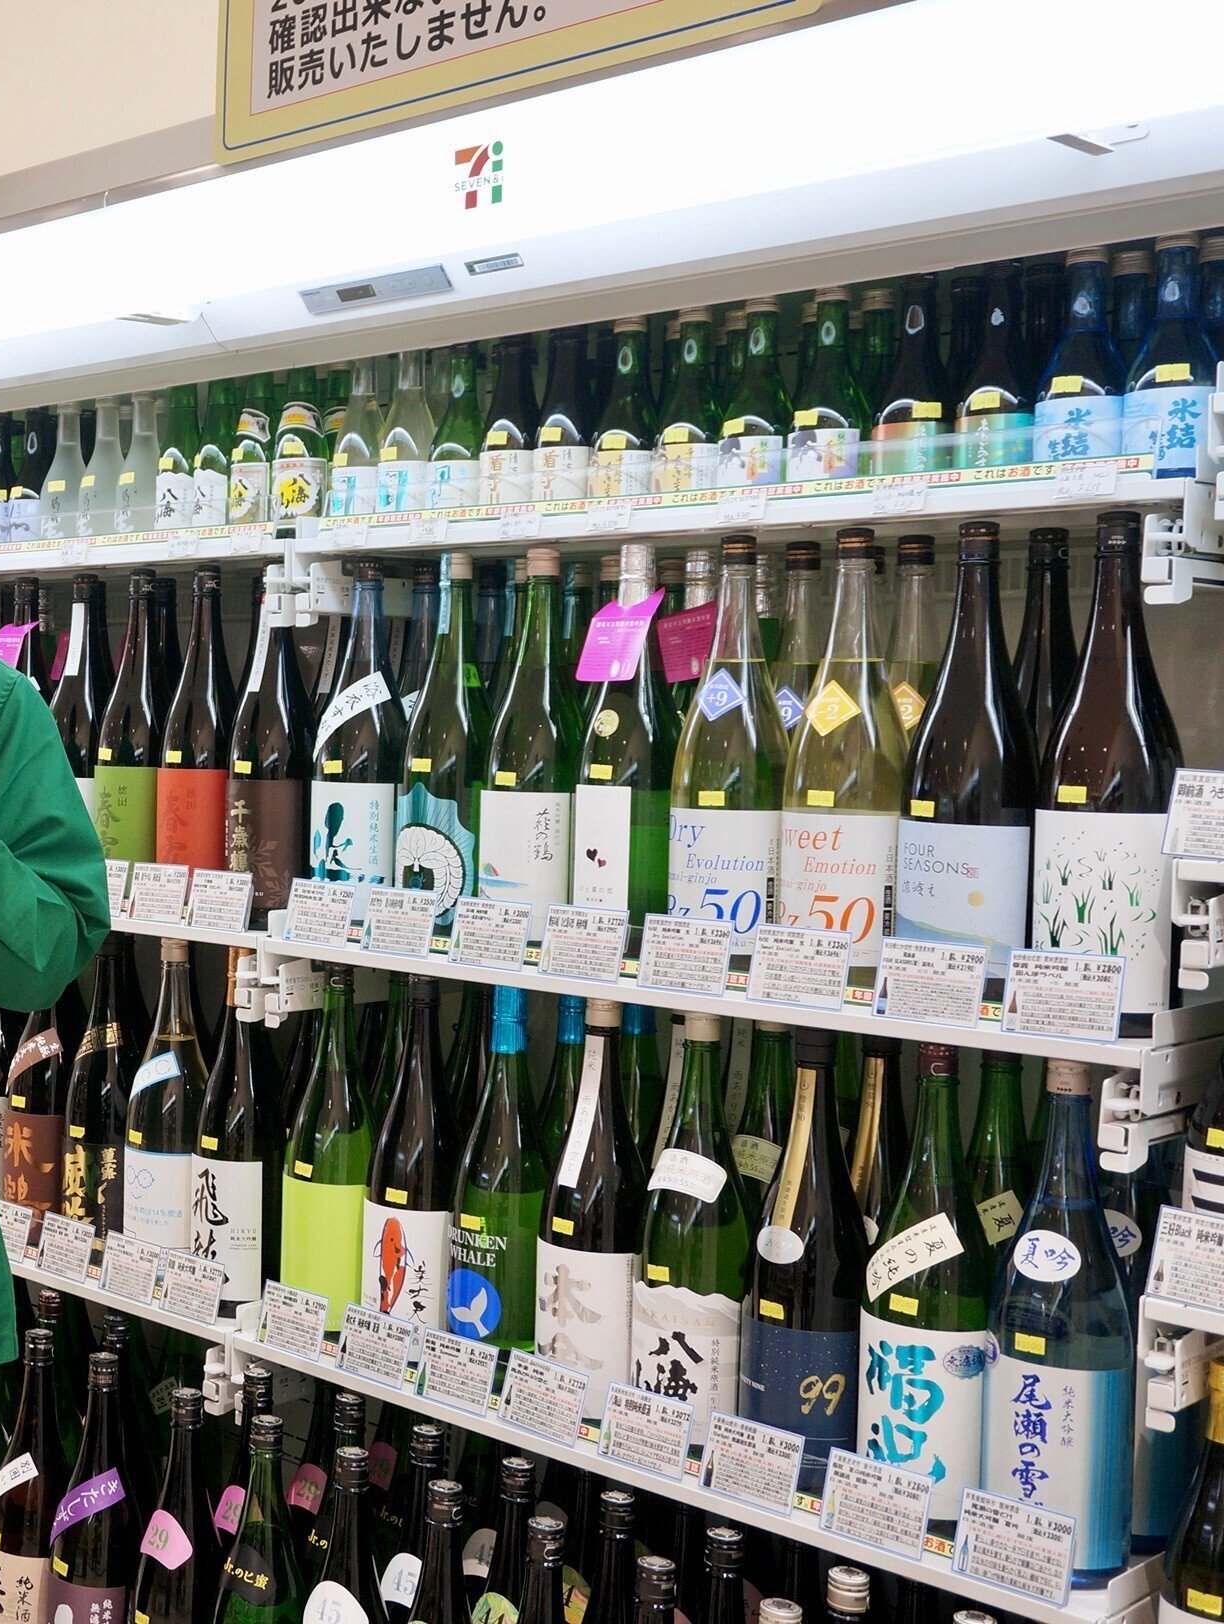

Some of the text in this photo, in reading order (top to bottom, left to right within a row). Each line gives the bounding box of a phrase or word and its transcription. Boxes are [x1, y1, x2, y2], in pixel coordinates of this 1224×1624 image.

[266, 5, 547, 99] 販売いたしません。
[706, 691, 728, 707] +9
[1177, 783, 1204, 798] 御前酒
[230, 800, 252, 873] 千歳鶴
[368, 800, 379, 866] 特別純米生酒
[783, 824, 844, 851] weet
[904, 842, 935, 857] FOUR
[686, 853, 764, 872] Evolution
[804, 856, 877, 875] Emotion
[903, 857, 970, 875] SEASONS
[580, 886, 614, 895] ひと夏の恋
[961, 954, 984, 964] ¥2900
[1097, 964, 1122, 974] ¥2800
[1016, 970, 1063, 979] 田んぼラベル
[448, 1224, 507, 1251] DRUNKEN
[450, 1244, 496, 1267] WHALE
[1020, 1237, 1075, 1272] 夏吟
[710, 1339, 720, 1392] 特別純米原酒
[798, 1373, 846, 1416] 99
[1061, 1386, 1075, 1449] 純米大吟醸
[779, 1440, 800, 1453] ¥3000
[1012, 1374, 1051, 1506] 尾瀬の雪
[907, 1479, 930, 1494] ¥2800
[53, 1479, 118, 1528] きたしず
[147, 1525, 170, 1550] 29
[1048, 1520, 1072, 1535] ¥3000
[392, 1569, 417, 1594] 45
[16, 1576, 34, 1622] 純米酒
[317, 1599, 343, 1624] 45
